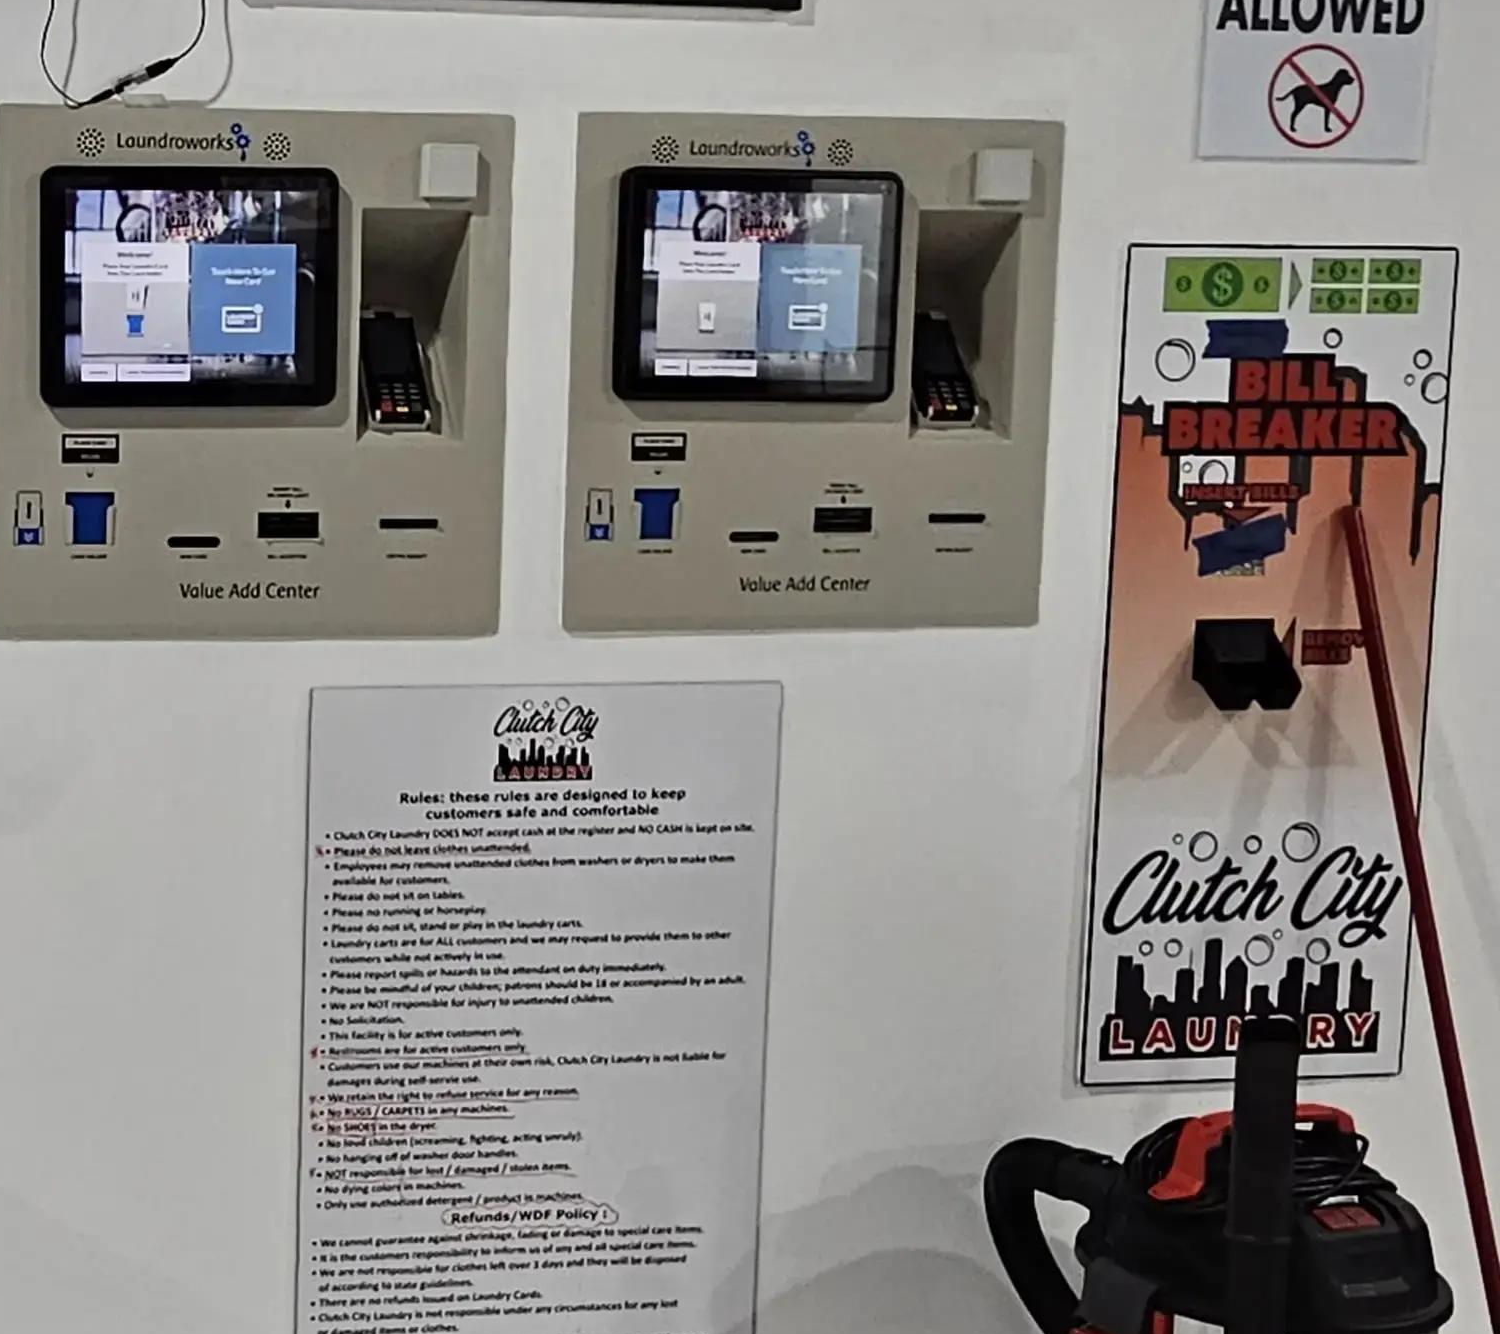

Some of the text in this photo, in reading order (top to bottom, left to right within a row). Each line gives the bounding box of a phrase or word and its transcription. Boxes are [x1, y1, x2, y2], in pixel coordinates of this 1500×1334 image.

[115, 130, 235, 152] Laundroworks
[689, 138, 800, 158] Laundroworks
[1235, 360, 1337, 403] BILL
[1167, 408, 1398, 451] BREAKER
[179, 582, 320, 601] Value Add Center
[739, 575, 871, 594] Value Add Center
[493, 705, 599, 743] Clutch City
[496, 765, 591, 780] LAUNDRY
[400, 788, 686, 805] Rules: these rules are designed to keep
[426, 804, 659, 820] customers safe and comfortable
[334, 846, 366, 856] Please
[369, 846, 381, 856] do
[385, 846, 401, 856] not
[404, 845, 430, 855] leave
[433, 844, 468, 855] clothes
[333, 892, 364, 902] Please
[367, 891, 380, 901] do
[383, 892, 400, 901] not
[403, 891, 414, 901] sit
[1102, 845, 1403, 948] Clutch City
[327, 1108, 342, 1118] No
[345, 1107, 371, 1116] RUGS
[381, 1106, 425, 1116] CARPETS
[427, 1106, 438, 1115] in
[440, 1106, 458, 1116] any
[461, 1104, 508, 1114] machines.
[451, 1210, 551, 1225] Refunds/WDF
[557, 1208, 598, 1221] Policy
